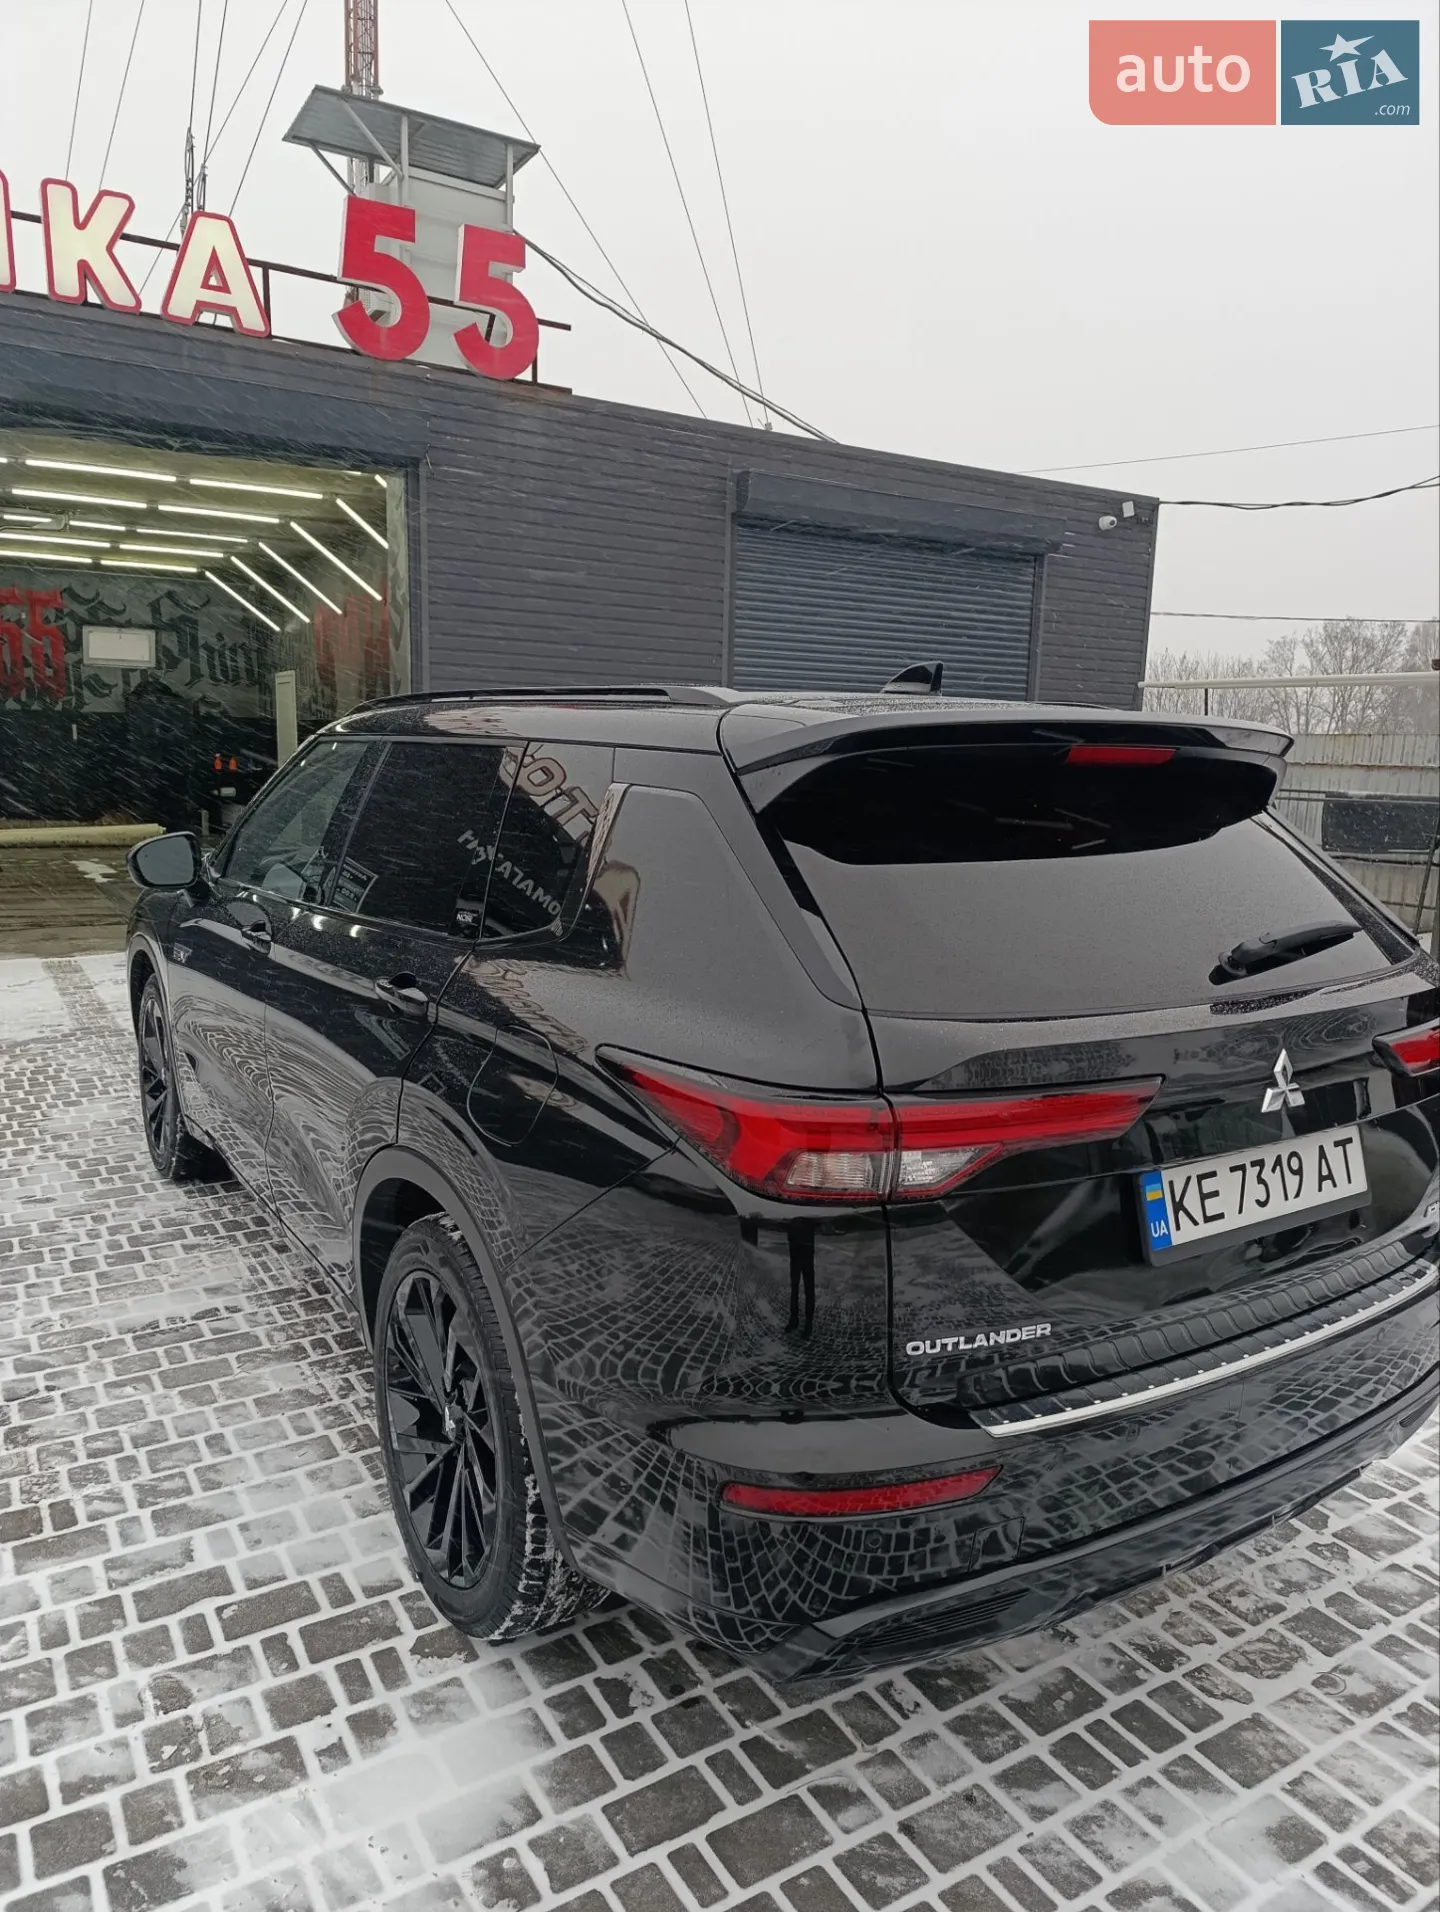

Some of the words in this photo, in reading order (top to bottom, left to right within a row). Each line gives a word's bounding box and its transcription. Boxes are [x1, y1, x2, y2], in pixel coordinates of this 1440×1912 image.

[0, 168, 271, 338] КА
[331, 194, 539, 381] 55
[1168, 1170, 1225, 1232] KE
[1229, 1150, 1304, 1215] 7319
[1316, 1137, 1355, 1193] AT
[1150, 1219, 1169, 1238] UA
[905, 1322, 1052, 1356] OUTLANDER
